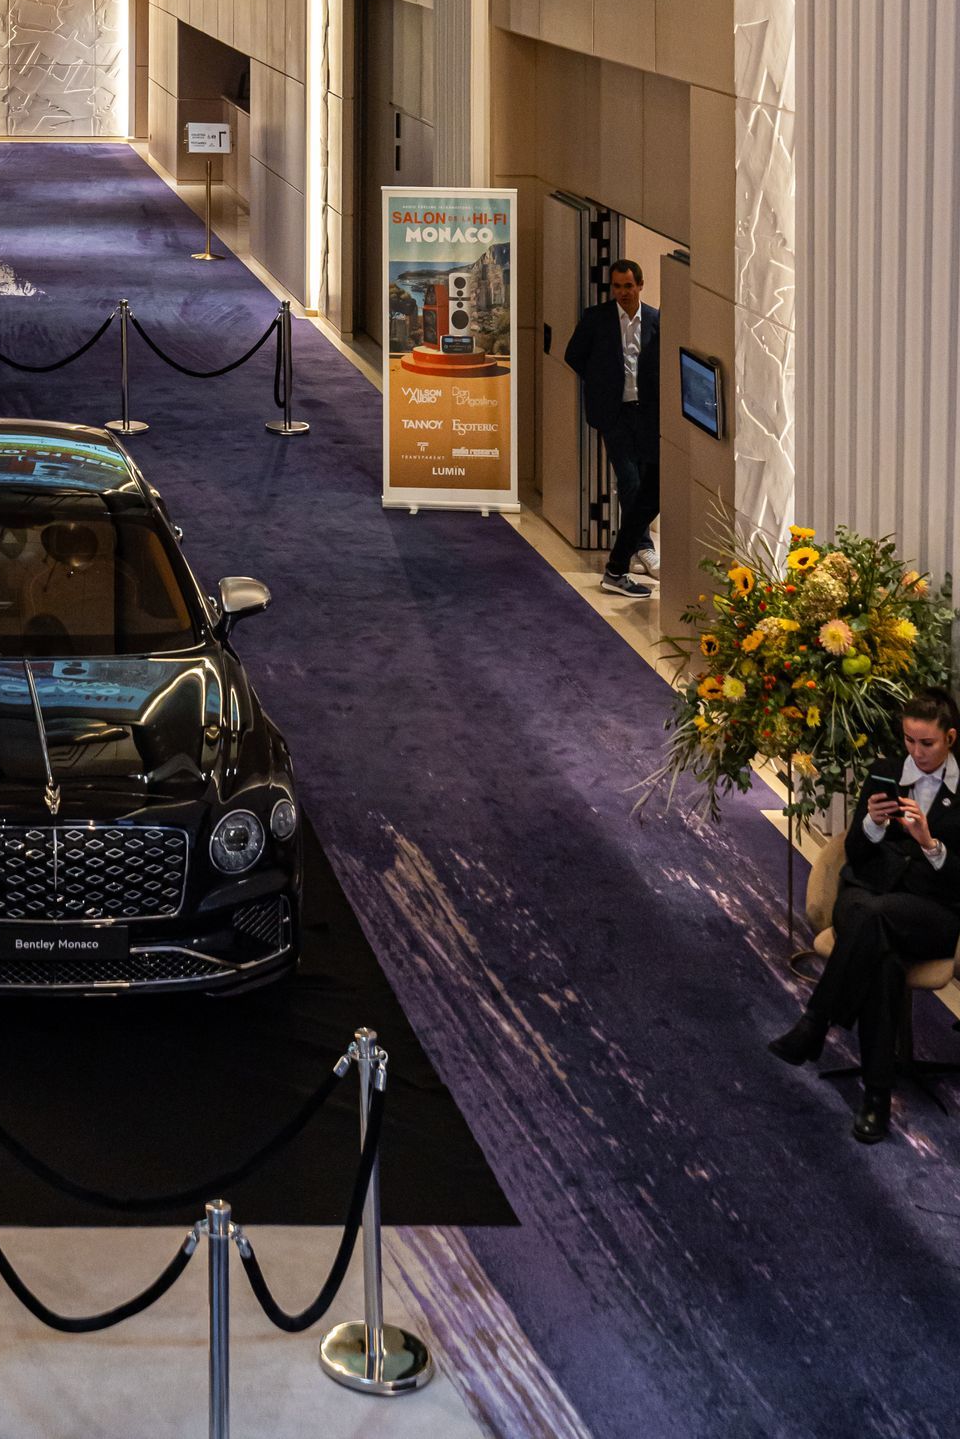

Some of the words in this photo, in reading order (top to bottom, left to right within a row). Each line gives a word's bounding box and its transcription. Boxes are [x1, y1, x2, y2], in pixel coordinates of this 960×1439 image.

[392, 211, 446, 225] SALON
[472, 212, 507, 225] HI-FI
[405, 226, 494, 243] MONACO
[401, 419, 443, 429] TANNOY
[15, 939, 55, 950] Bentley
[58, 939, 99, 949] Monaco
